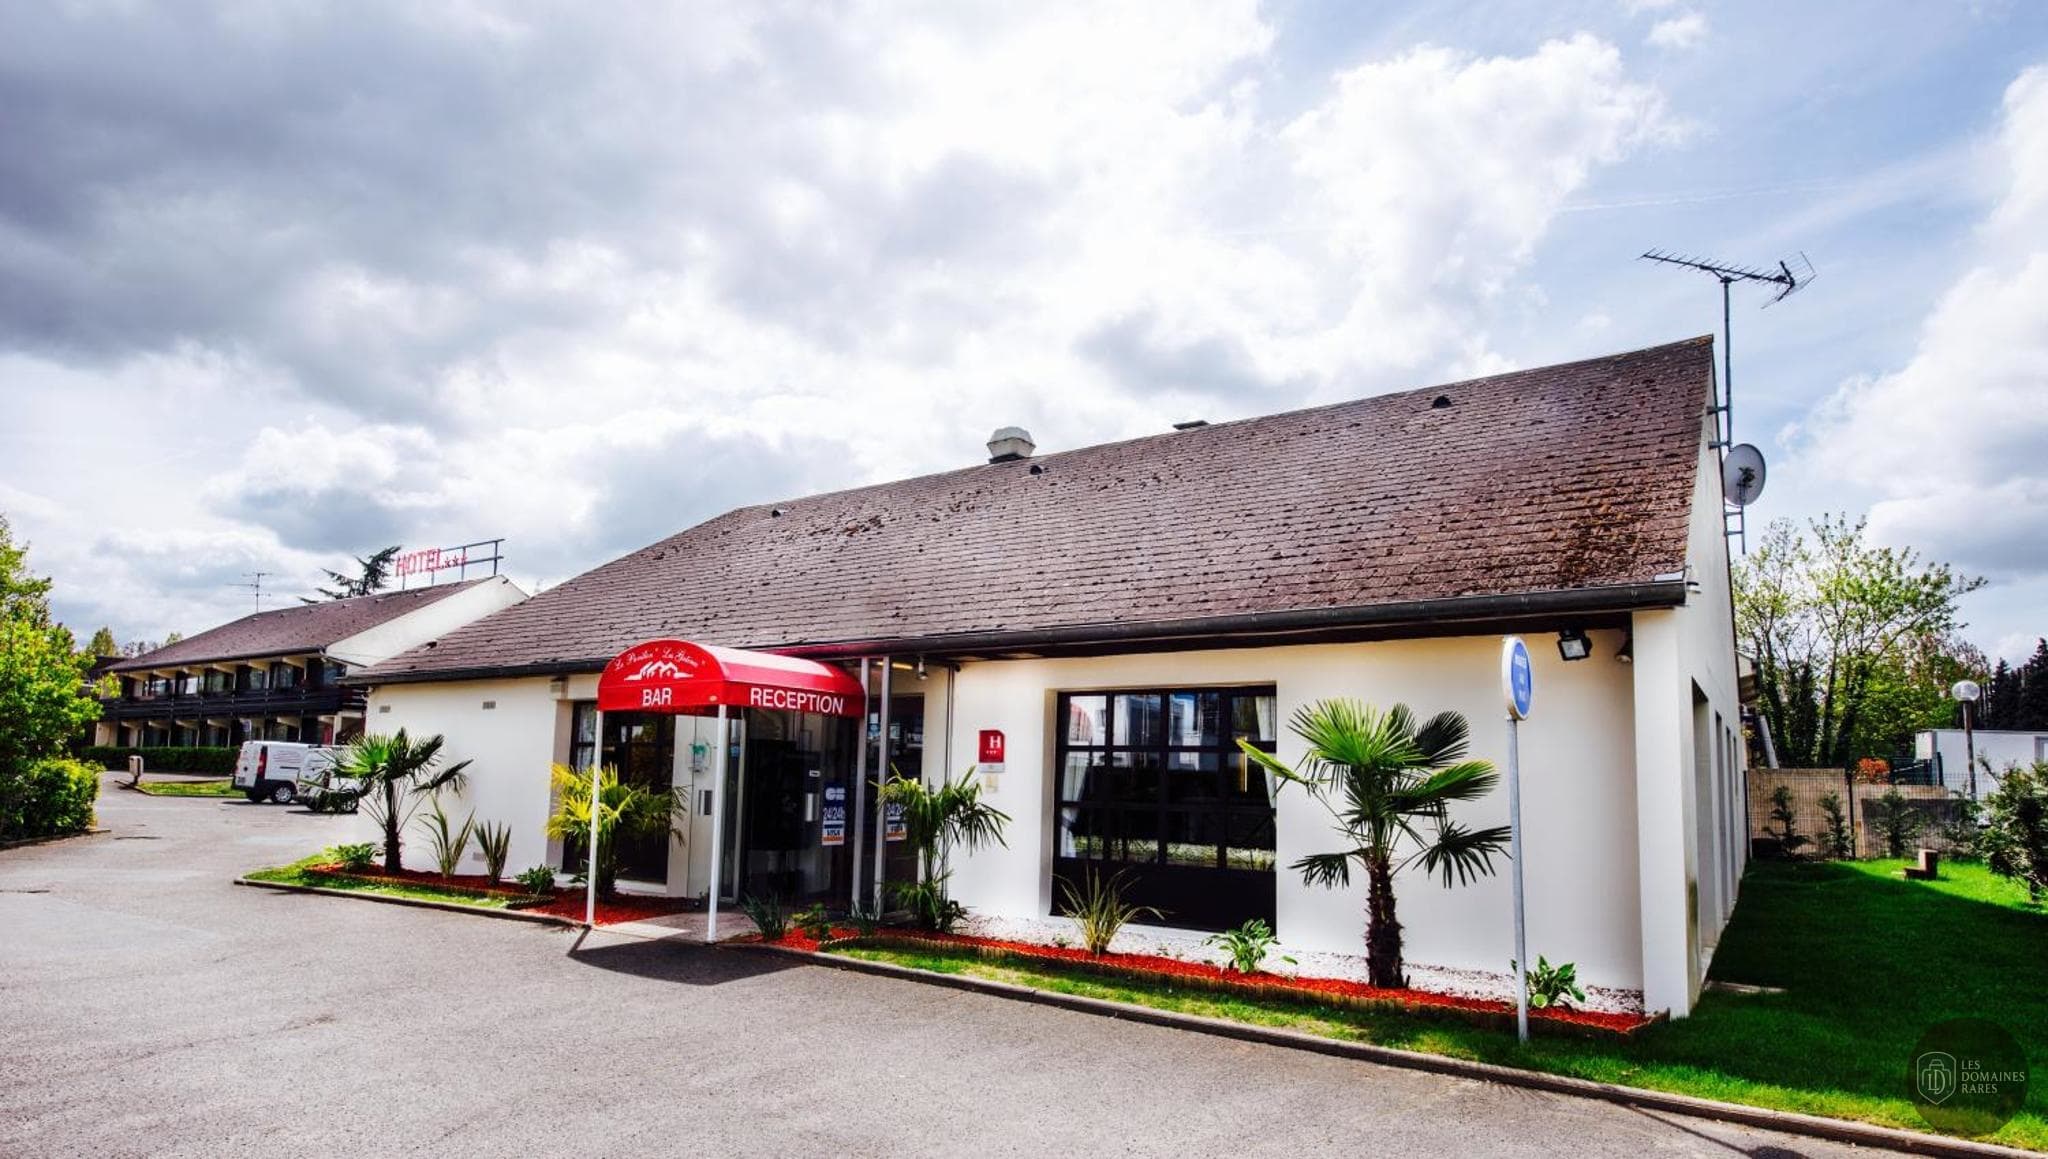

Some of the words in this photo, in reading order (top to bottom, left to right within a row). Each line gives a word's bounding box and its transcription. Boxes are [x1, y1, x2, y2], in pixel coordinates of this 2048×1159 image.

[396, 548, 444, 576] HOTEL
[642, 687, 672, 707] BAR
[750, 687, 844, 714] RECEPTION
[989, 735, 1001, 749] H
